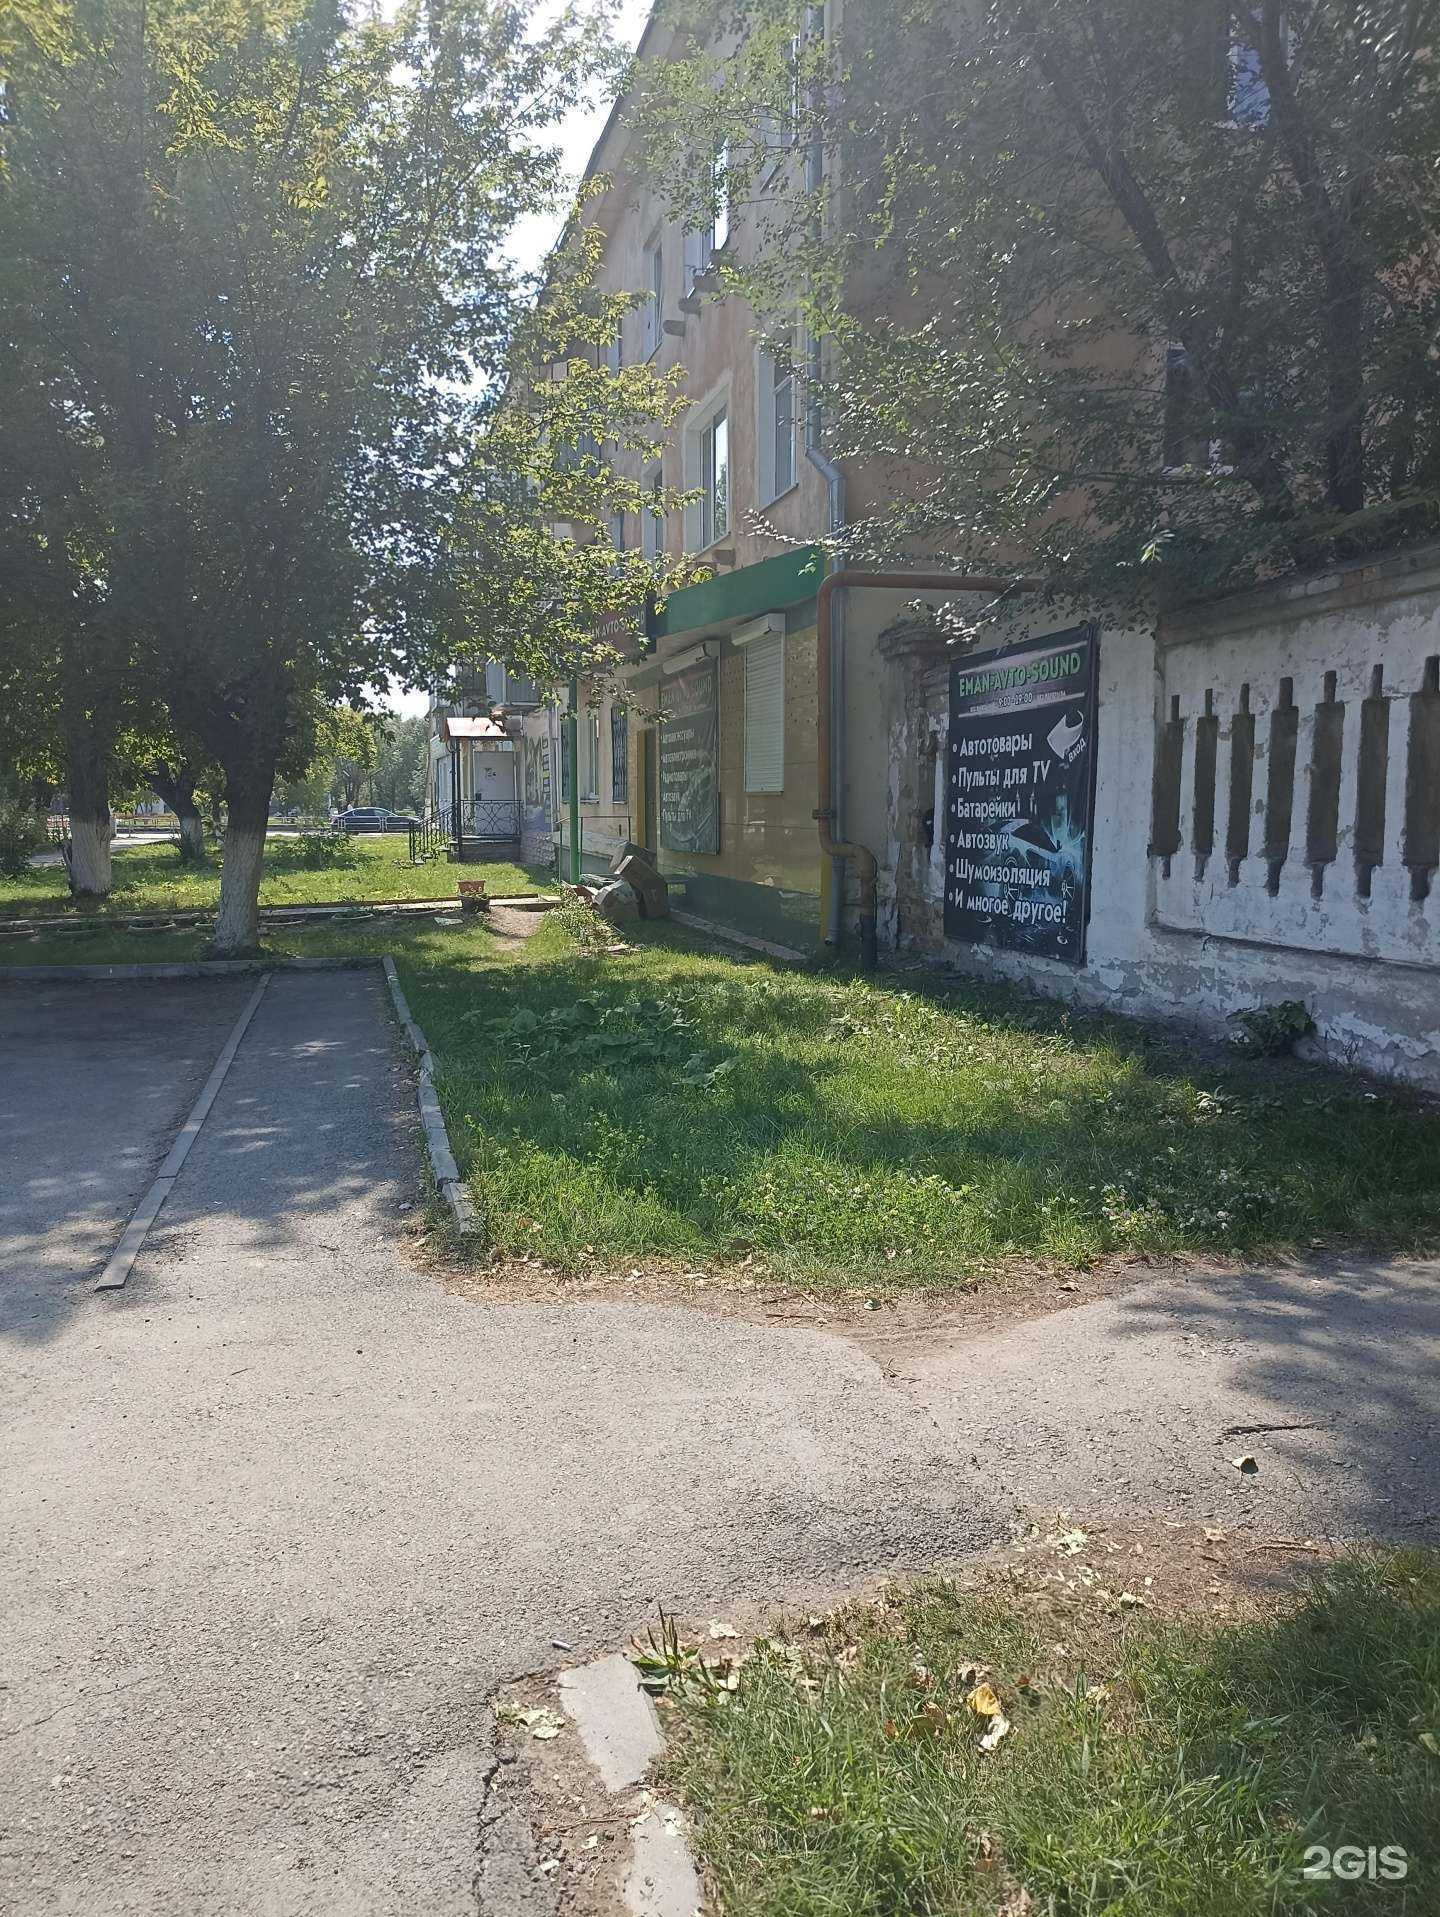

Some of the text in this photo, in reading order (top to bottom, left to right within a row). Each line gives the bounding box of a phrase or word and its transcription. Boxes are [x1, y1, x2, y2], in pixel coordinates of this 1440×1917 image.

[959, 652, 1081, 698] EMAN-AVTO-SOUND
[960, 733, 1032, 757] Автотовары
[958, 759, 1051, 792] Пульты для TV
[957, 796, 1016, 822] Батарейки
[957, 829, 1009, 854] Автозвук
[956, 858, 1051, 889] Шумоизоляция
[954, 888, 1067, 924] И многое другое!
